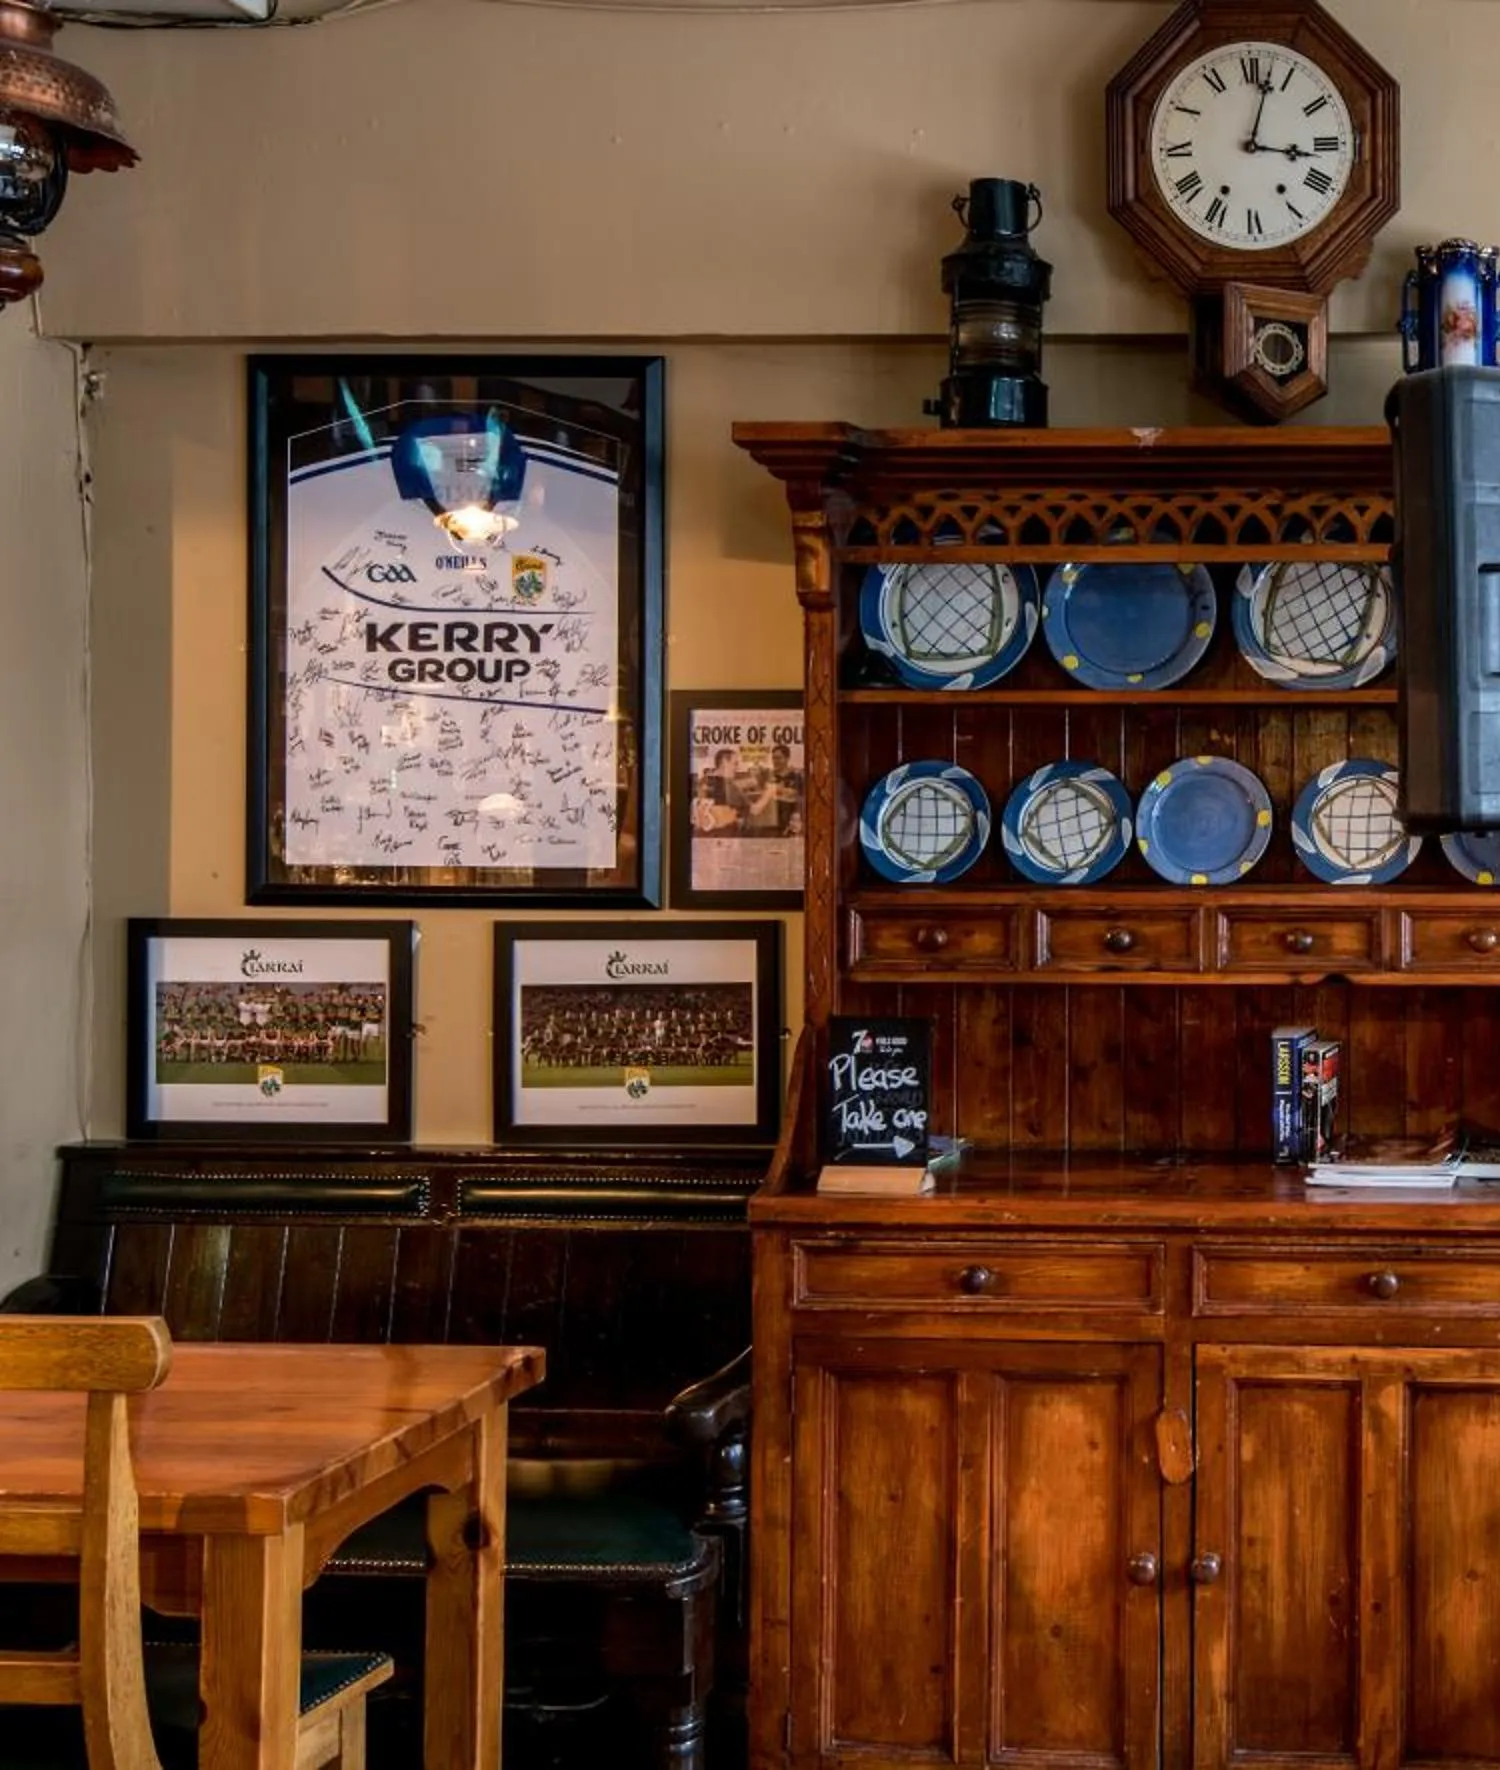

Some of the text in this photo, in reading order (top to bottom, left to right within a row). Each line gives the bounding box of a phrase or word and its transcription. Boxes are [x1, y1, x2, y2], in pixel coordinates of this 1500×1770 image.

[1313, 136, 1339, 151] III
[366, 622, 554, 653] KERRY
[387, 658, 531, 683] GROUP
[694, 726, 805, 744] CROKE OF GOL
[829, 1053, 919, 1091] Please
[832, 1093, 887, 1134] Take
